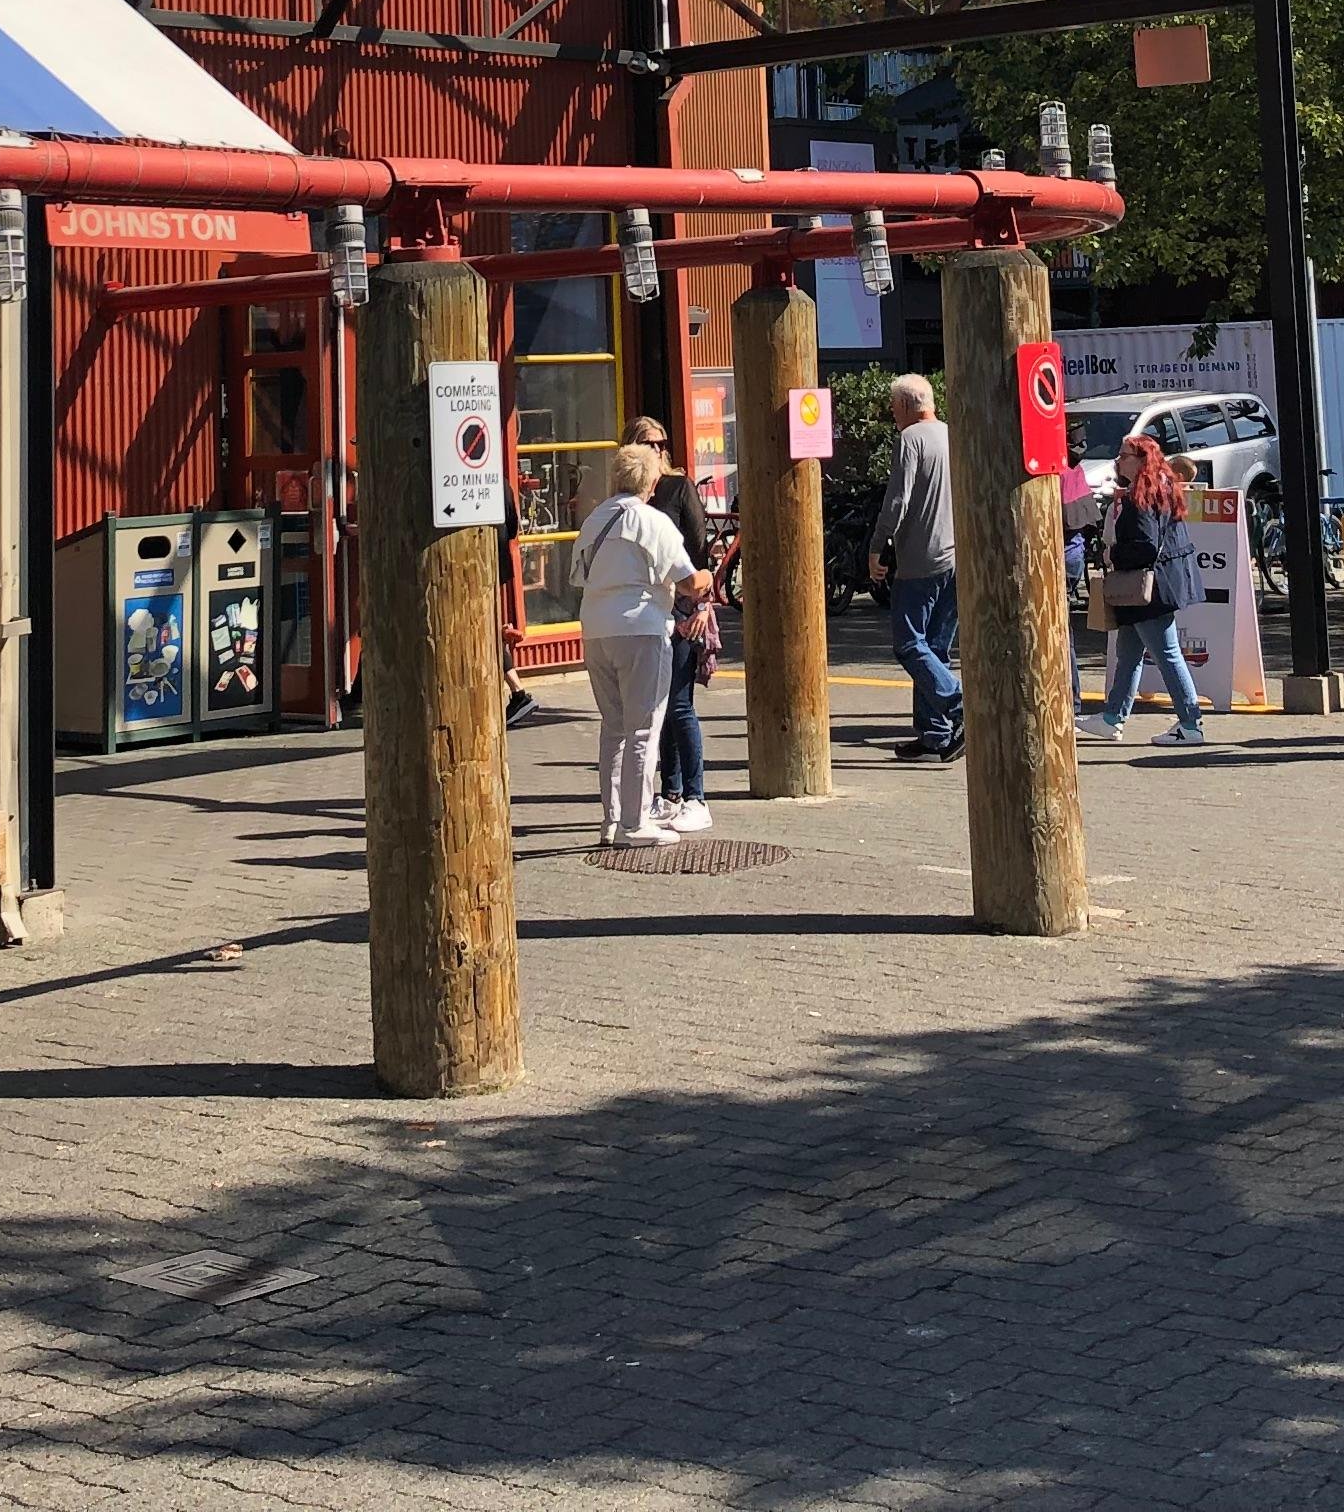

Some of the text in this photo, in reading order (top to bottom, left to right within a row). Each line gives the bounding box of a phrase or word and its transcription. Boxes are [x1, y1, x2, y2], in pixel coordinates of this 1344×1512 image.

[60, 208, 237, 241] JOHNSTON
[1050, 270, 1087, 279] TAURA
[1062, 354, 1118, 376] teelBox
[1198, 361, 1240, 372] DEMAND
[435, 384, 498, 398] COMMERCIAL
[450, 399, 492, 412] LOADING
[443, 473, 499, 488] 20 MIN MAX
[461, 487, 490, 501] 24 HR
